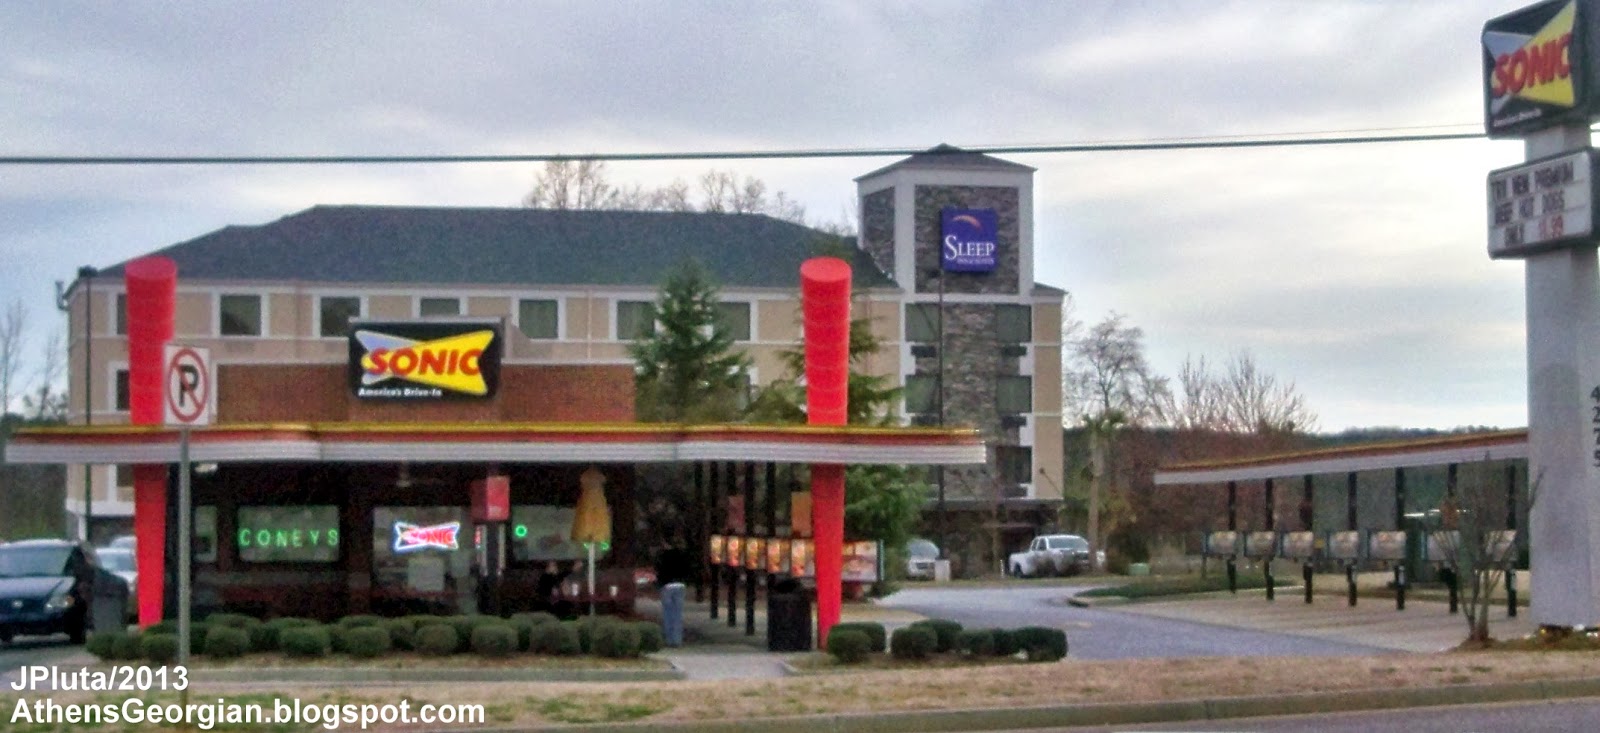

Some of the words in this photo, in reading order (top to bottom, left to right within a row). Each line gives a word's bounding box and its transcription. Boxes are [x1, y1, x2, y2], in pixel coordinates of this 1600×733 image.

[1492, 31, 1573, 97] SONIC
[368, 347, 482, 376] SONIC
[358, 387, 401, 397] America's
[238, 527, 339, 548] CONEYS
[402, 526, 455, 546] SONIC
